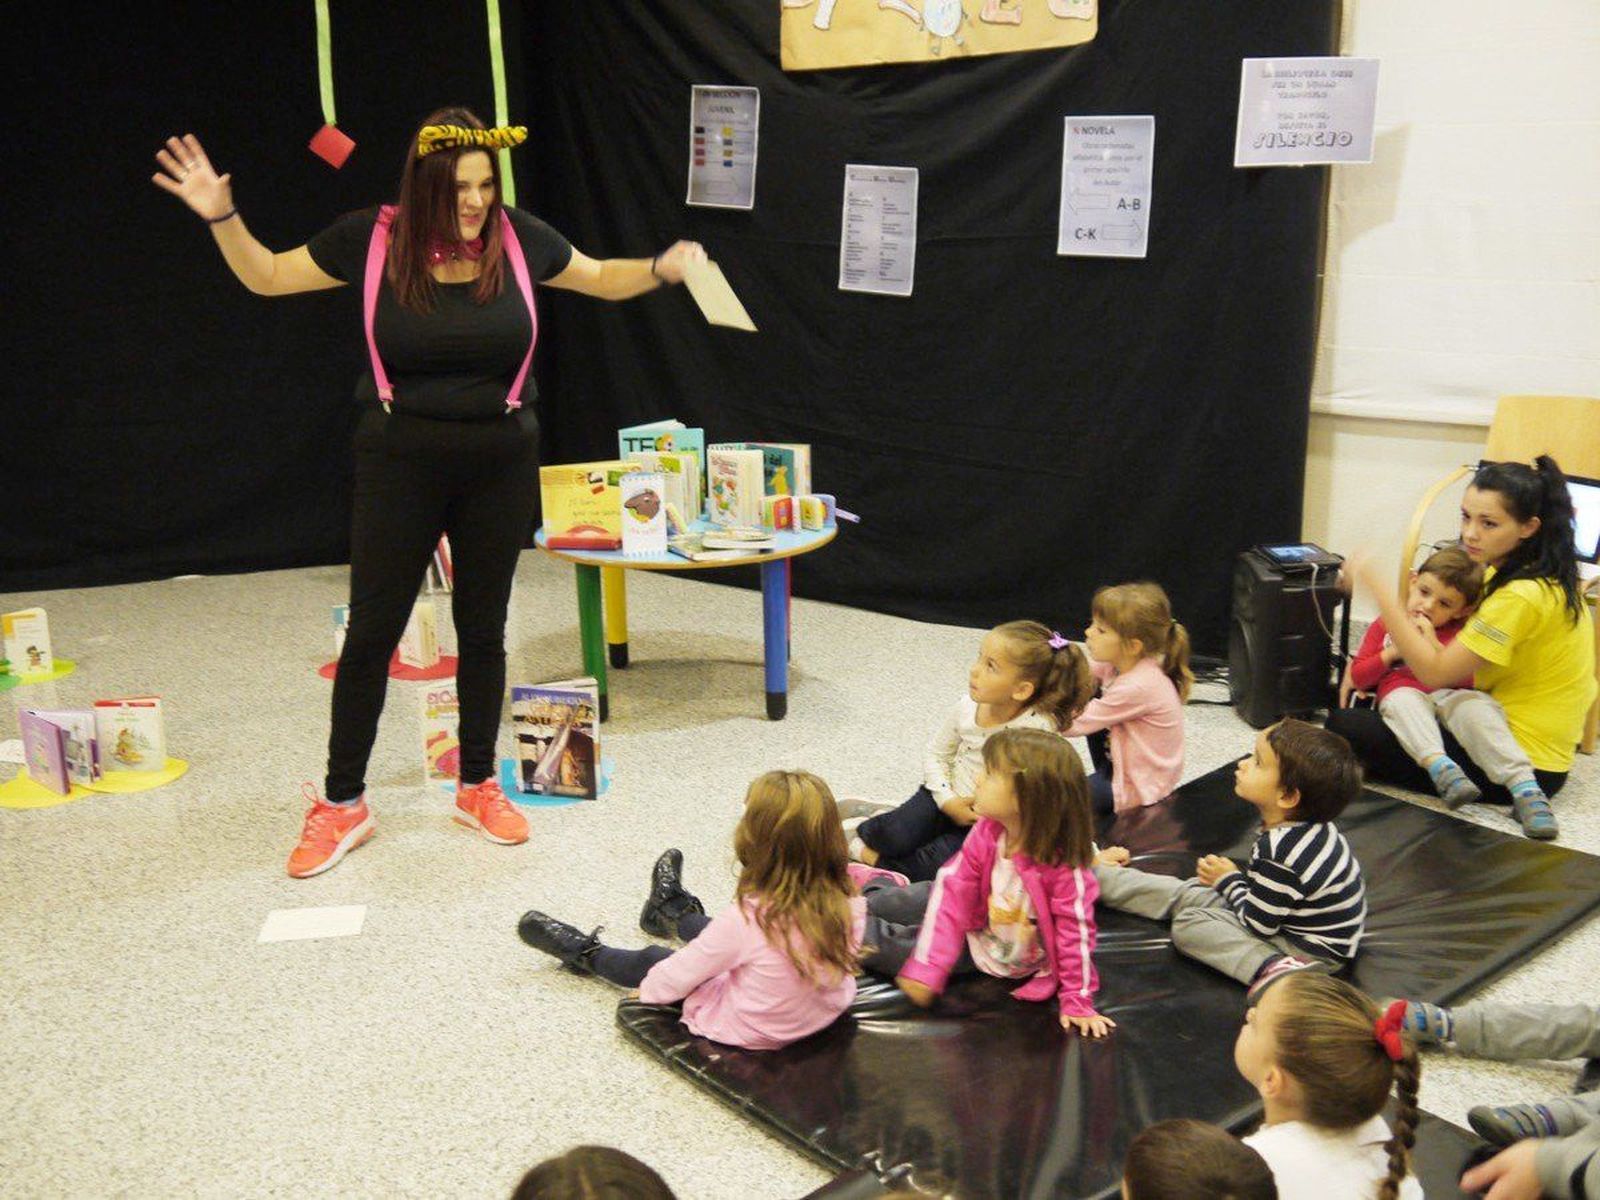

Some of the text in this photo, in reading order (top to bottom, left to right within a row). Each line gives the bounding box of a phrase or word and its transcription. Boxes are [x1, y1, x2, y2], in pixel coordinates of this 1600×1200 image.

[1081, 126, 1116, 135] NOVELA
[1252, 131, 1354, 150] SILENCIO
[1117, 197, 1141, 211] A-B
[1075, 227, 1097, 240] C-K
